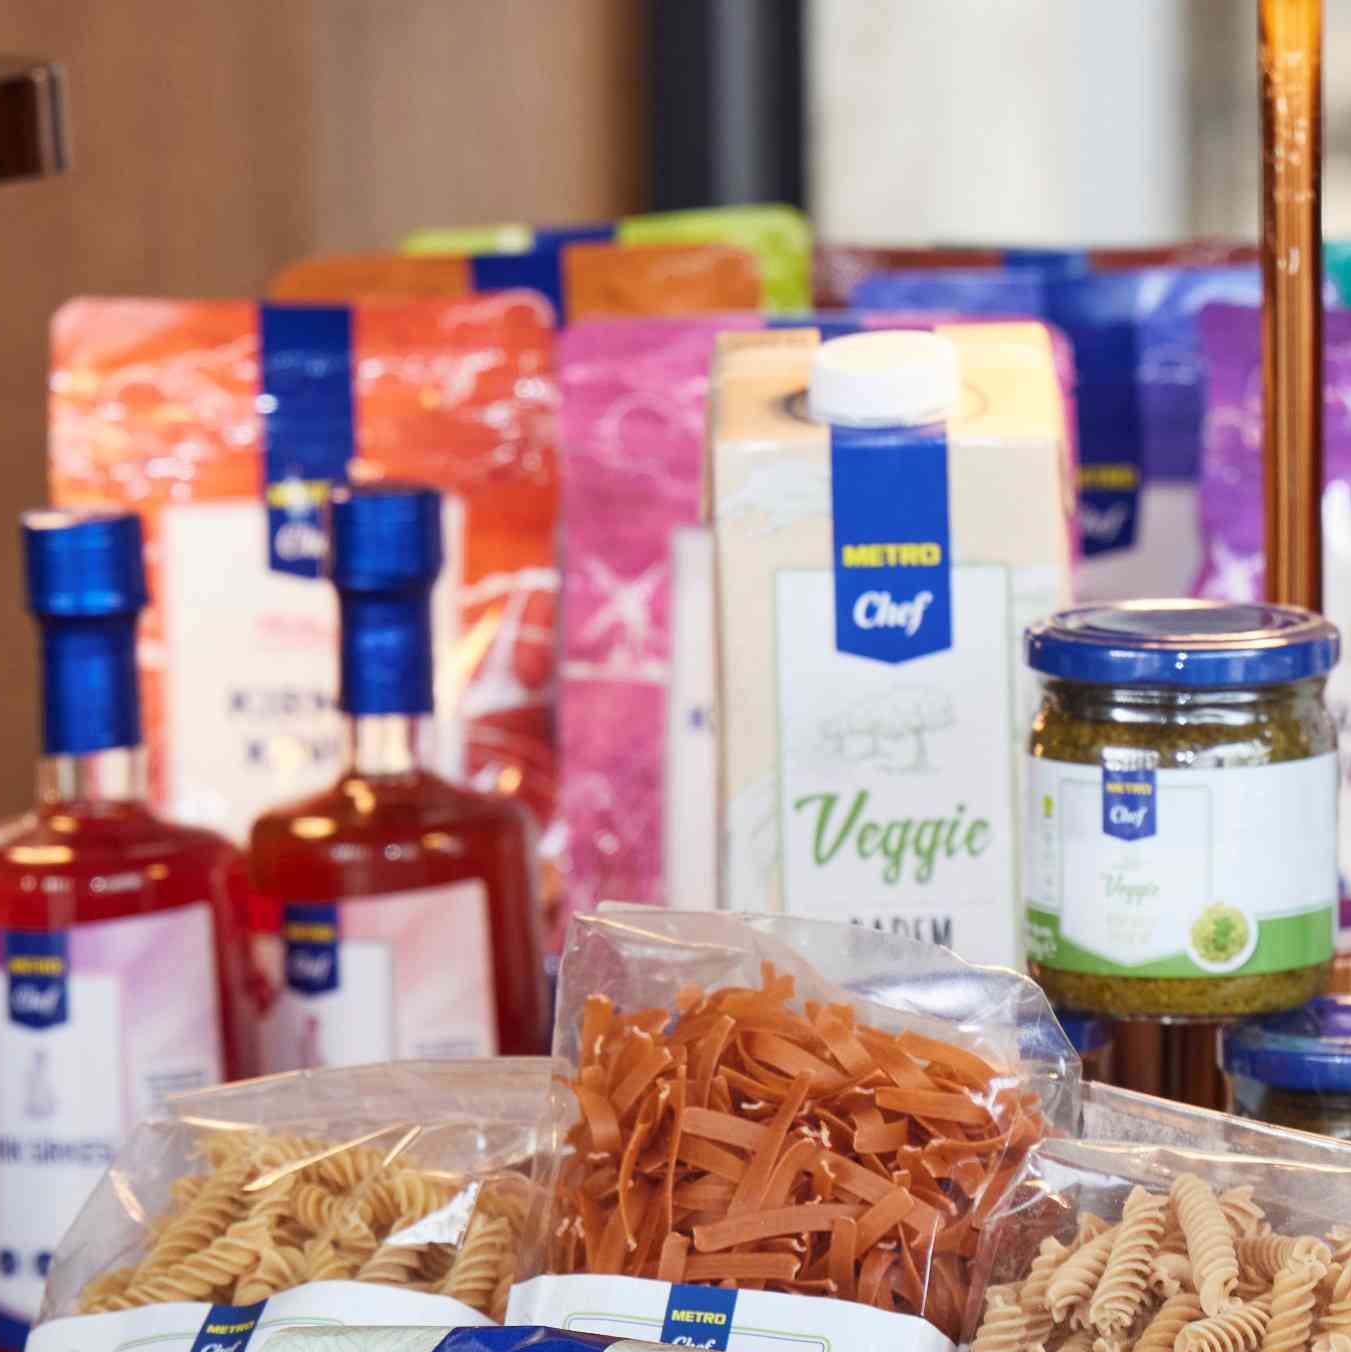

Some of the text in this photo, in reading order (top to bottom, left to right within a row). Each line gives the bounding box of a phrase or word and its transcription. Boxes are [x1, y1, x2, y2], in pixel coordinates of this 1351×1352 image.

[843, 545, 942, 566] METRO
[853, 591, 934, 636] Chef
[1109, 806, 1148, 828] Chef
[794, 788, 992, 886] Veggie
[206, 1320, 255, 1336] METRO
[671, 1309, 726, 1326] METRO
